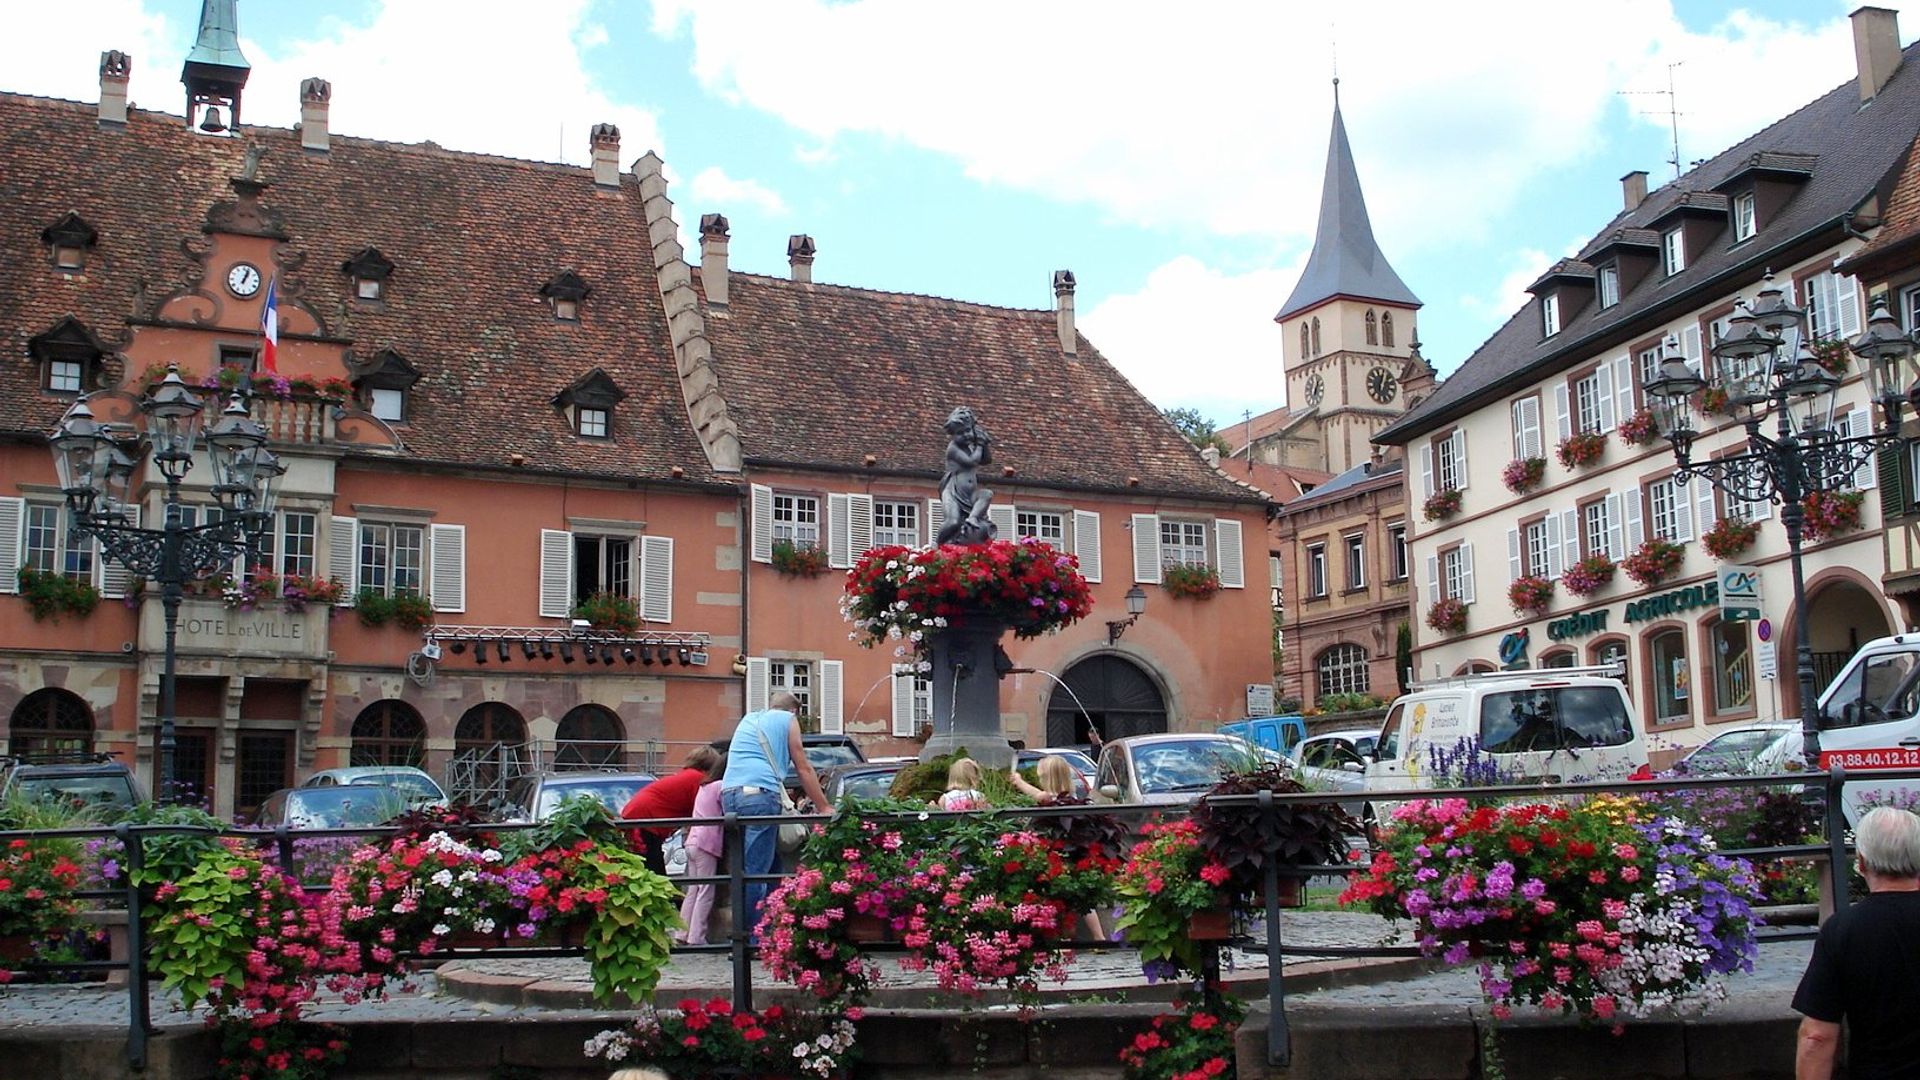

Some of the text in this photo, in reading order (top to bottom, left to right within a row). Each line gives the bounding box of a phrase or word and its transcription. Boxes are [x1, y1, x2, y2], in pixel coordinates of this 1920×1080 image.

[1724, 571, 1757, 593] CA
[1547, 609, 1609, 641] CRÉDIT
[1623, 581, 1720, 624] AGRICOLE
[238, 626, 251, 637] DE
[252, 622, 302, 639] VILLE
[1828, 751, 1919, 767] 03.88.40.12.12
